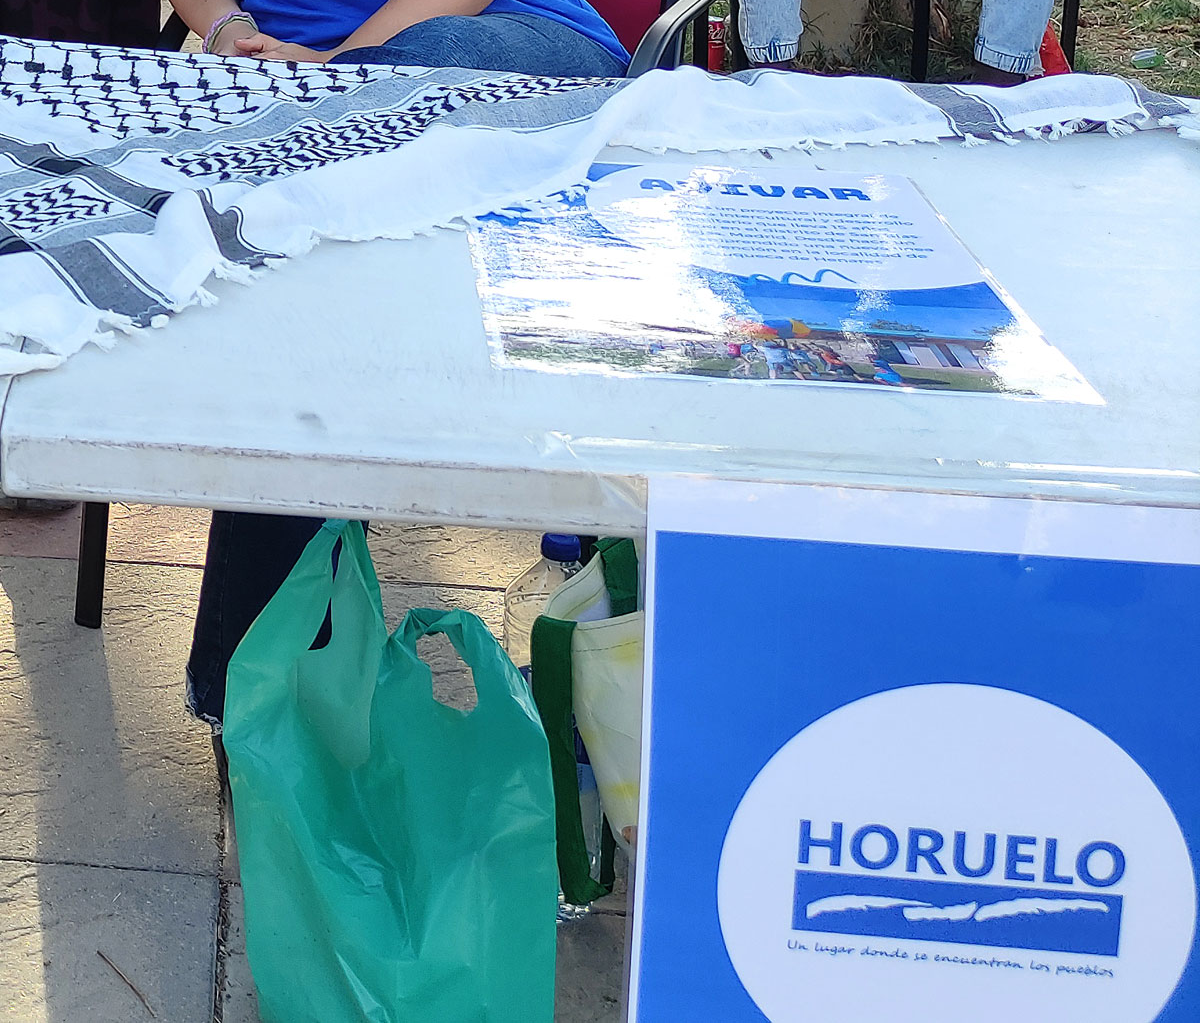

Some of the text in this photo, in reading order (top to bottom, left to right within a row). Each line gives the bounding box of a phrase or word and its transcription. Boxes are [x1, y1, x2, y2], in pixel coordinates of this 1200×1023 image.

[639, 178, 871, 201] AIVAR
[719, 212, 817, 222] intercultural
[700, 238, 799, 246] prendido
[703, 251, 784, 259] uqueca
[825, 250, 902, 258] localidad
[797, 819, 1126, 888] HORUELO
[787, 939, 1115, 978] Un lugar donde se encuentran los pueblos
